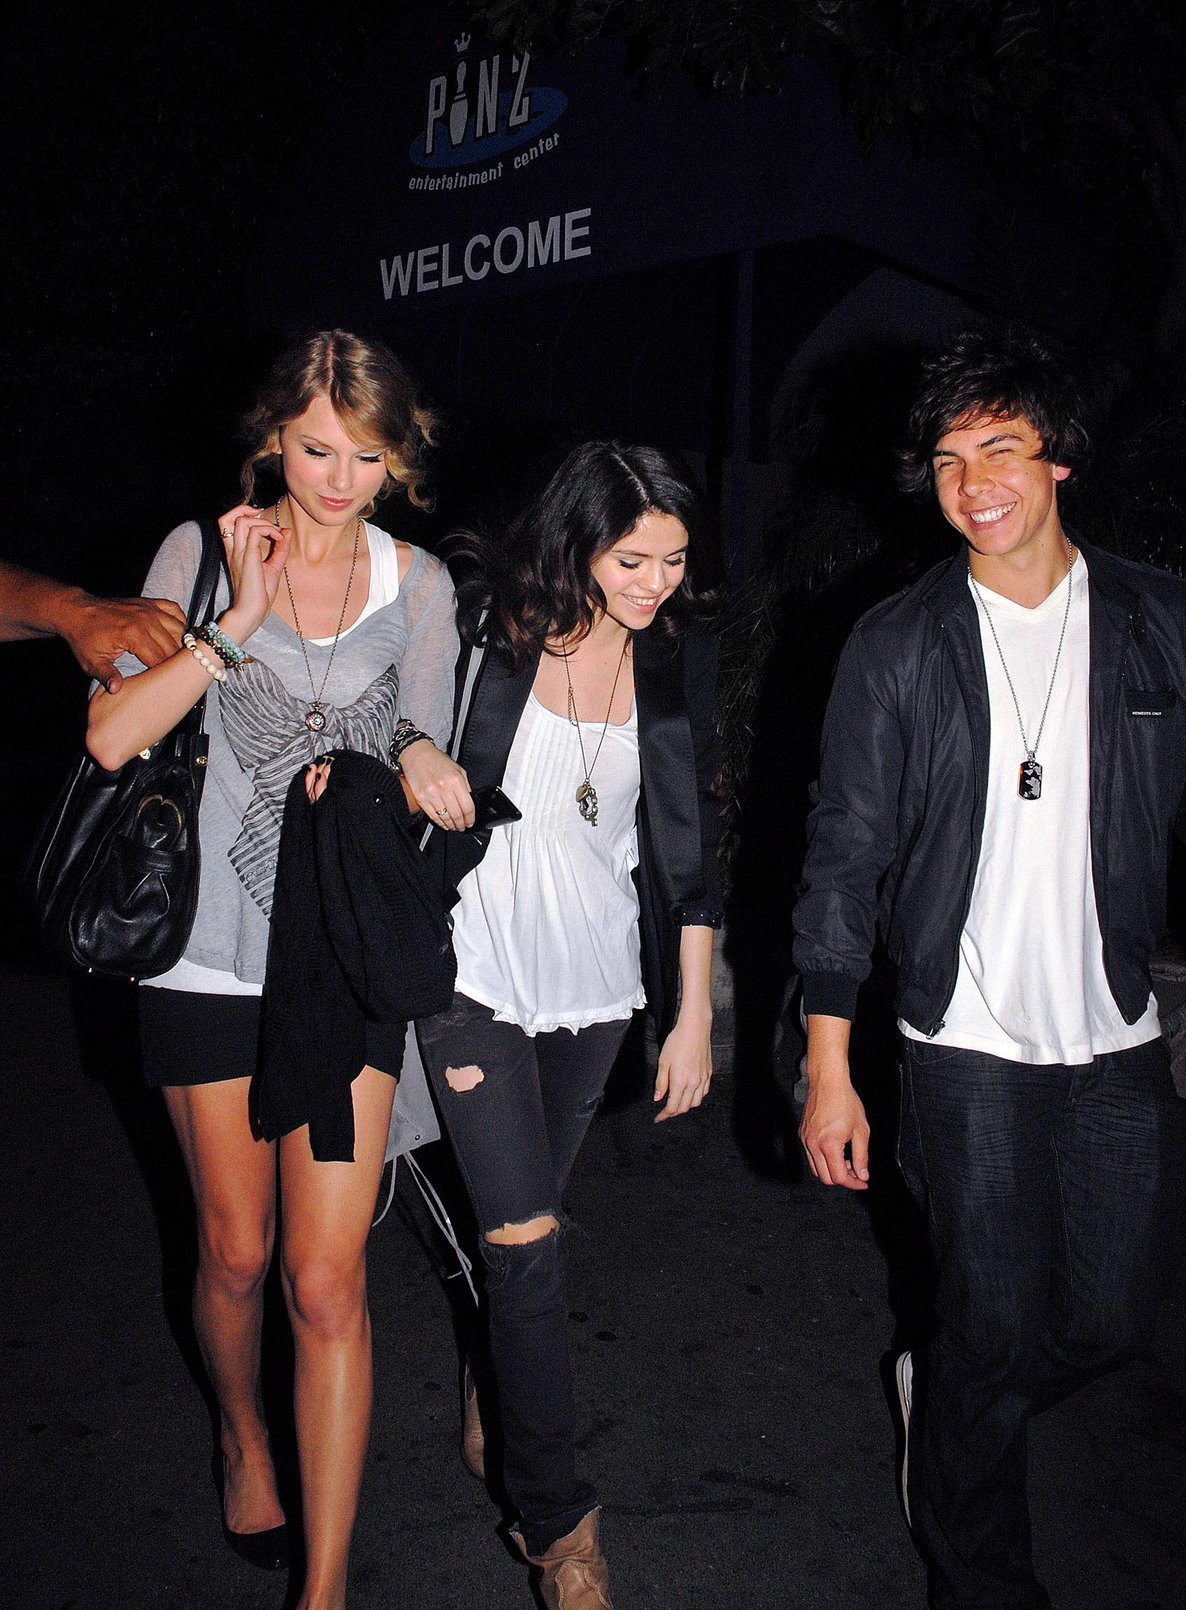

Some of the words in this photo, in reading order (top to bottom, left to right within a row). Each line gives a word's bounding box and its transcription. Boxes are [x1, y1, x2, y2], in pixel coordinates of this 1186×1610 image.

[408, 161, 504, 191] entertainment
[513, 132, 561, 170] center
[379, 207, 592, 301] WELCOME
